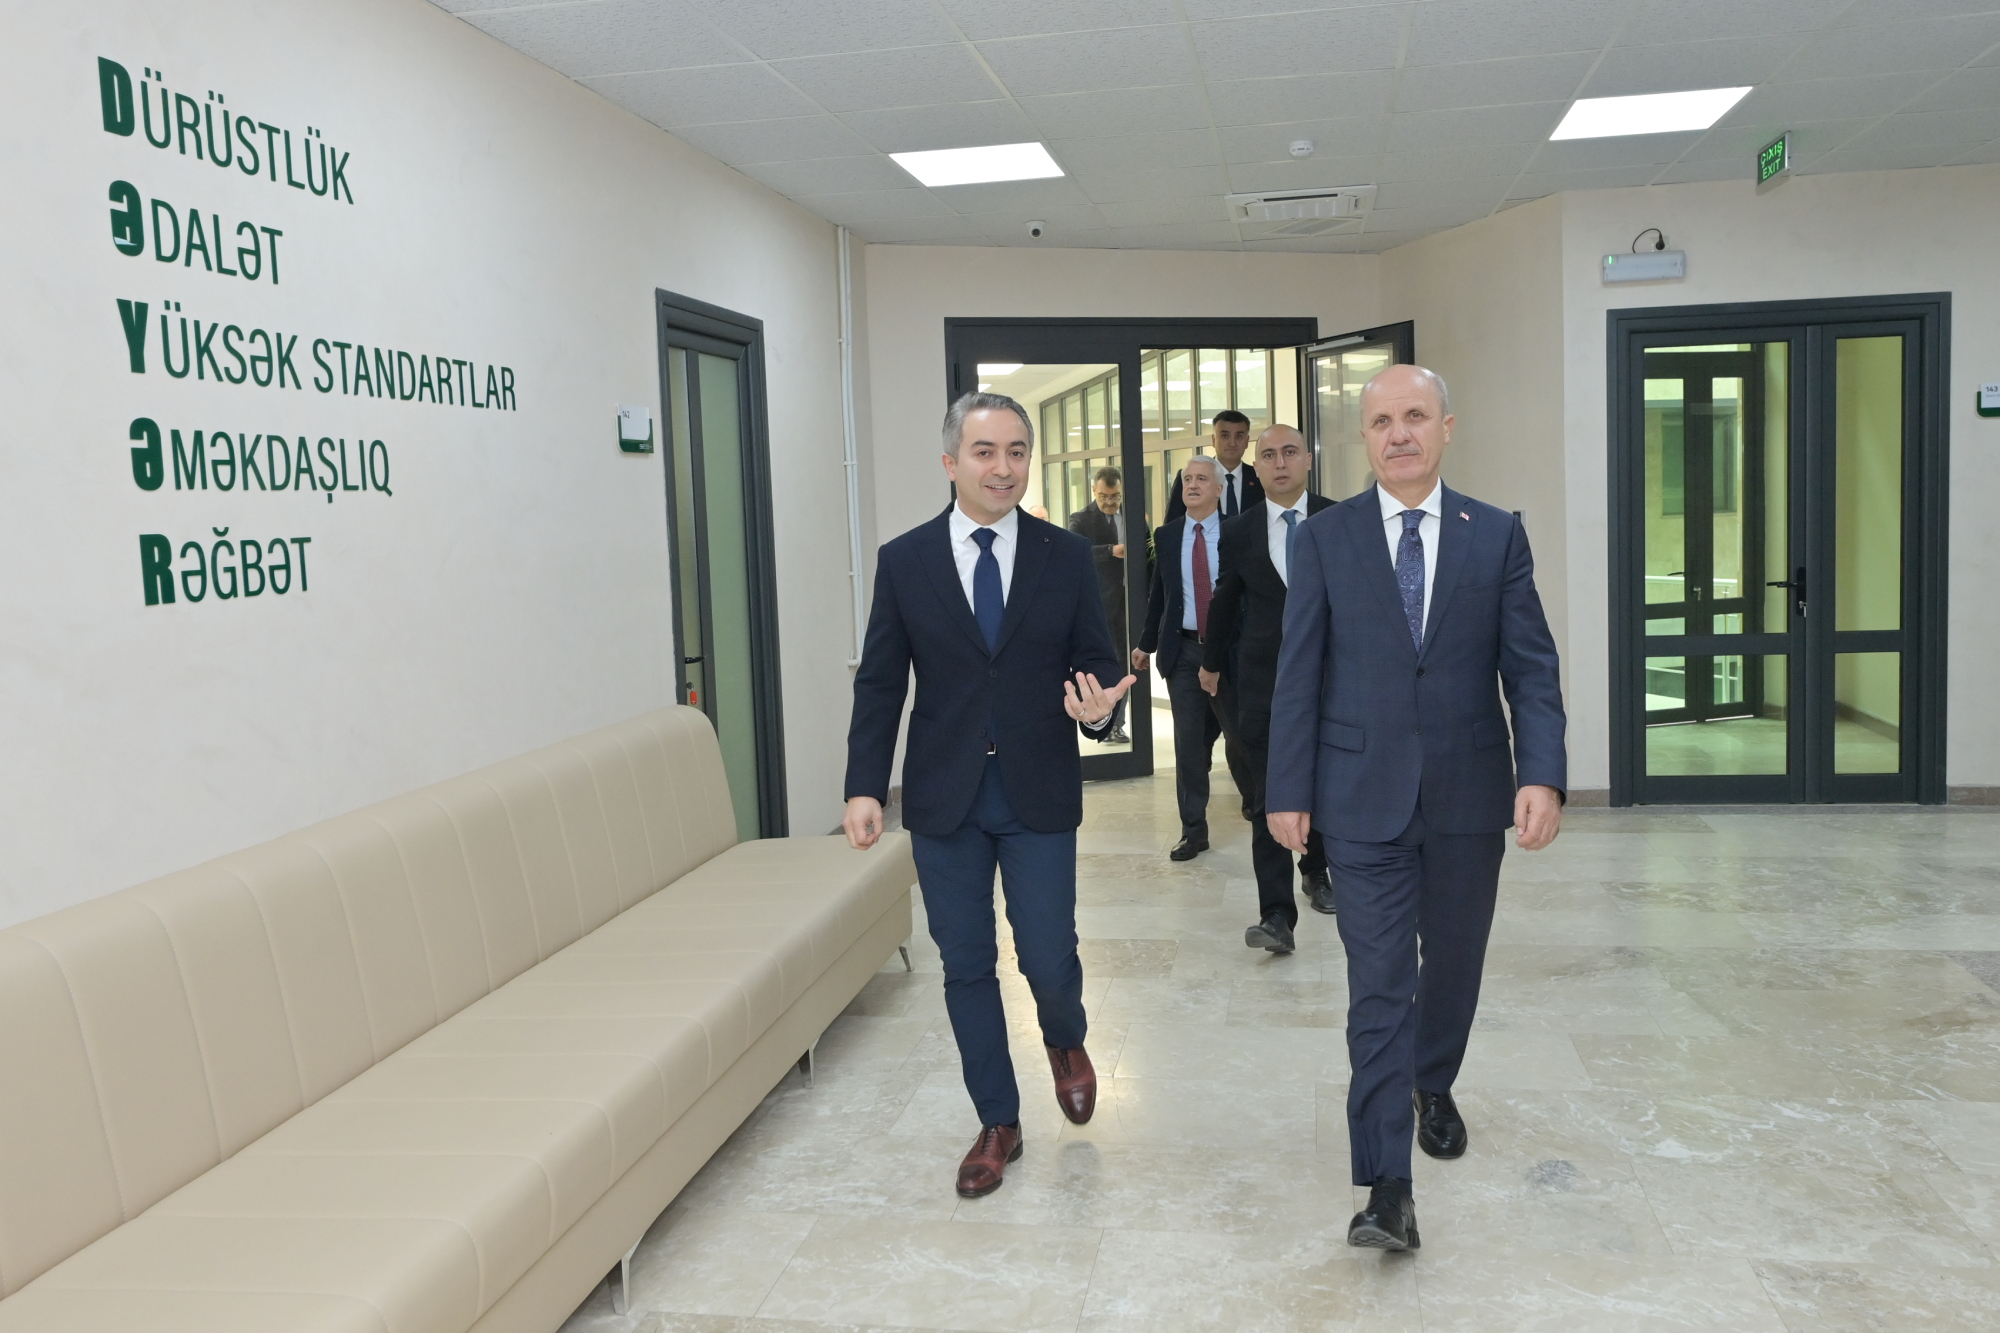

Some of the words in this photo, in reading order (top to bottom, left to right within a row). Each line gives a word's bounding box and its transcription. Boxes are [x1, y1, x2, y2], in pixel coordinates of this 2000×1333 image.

[98, 56, 354, 205] DÜRÜSTLÜK
[1760, 141, 1783, 168] ÇIXIŞ
[1762, 158, 1781, 180] EXIT
[108, 180, 283, 285] ƏDALƏT
[116, 298, 302, 390] YÜKSƏK
[313, 338, 517, 411] STANDARTLAR
[130, 417, 392, 504] ƏMƏKDAŞLIQ
[139, 527, 312, 606] RƏĞBƏT
